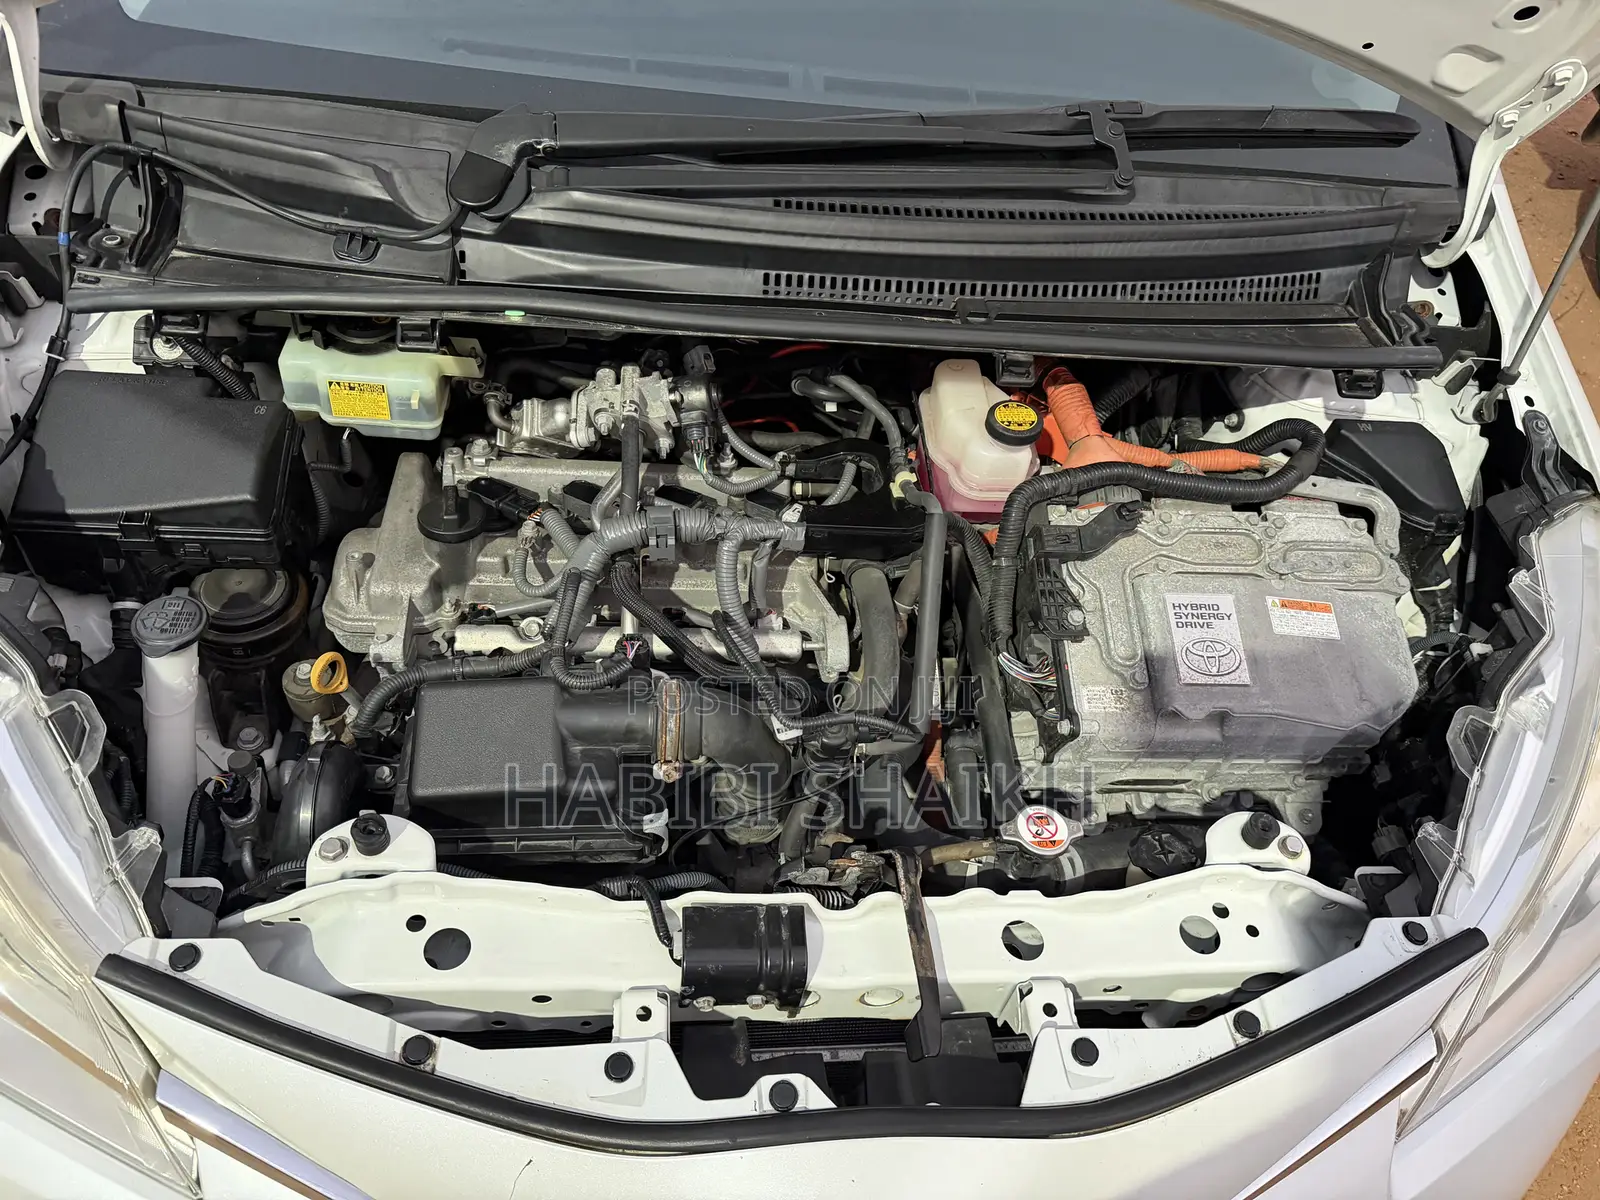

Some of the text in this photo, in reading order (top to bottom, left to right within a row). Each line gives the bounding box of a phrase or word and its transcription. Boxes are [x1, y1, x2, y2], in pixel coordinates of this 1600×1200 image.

[254, 404, 267, 415] C6
[1356, 422, 1373, 432] HV
[1172, 603, 1220, 611] HYBRID
[1174, 612, 1232, 620] SYNERGY
[1176, 621, 1215, 629] DRIVE
